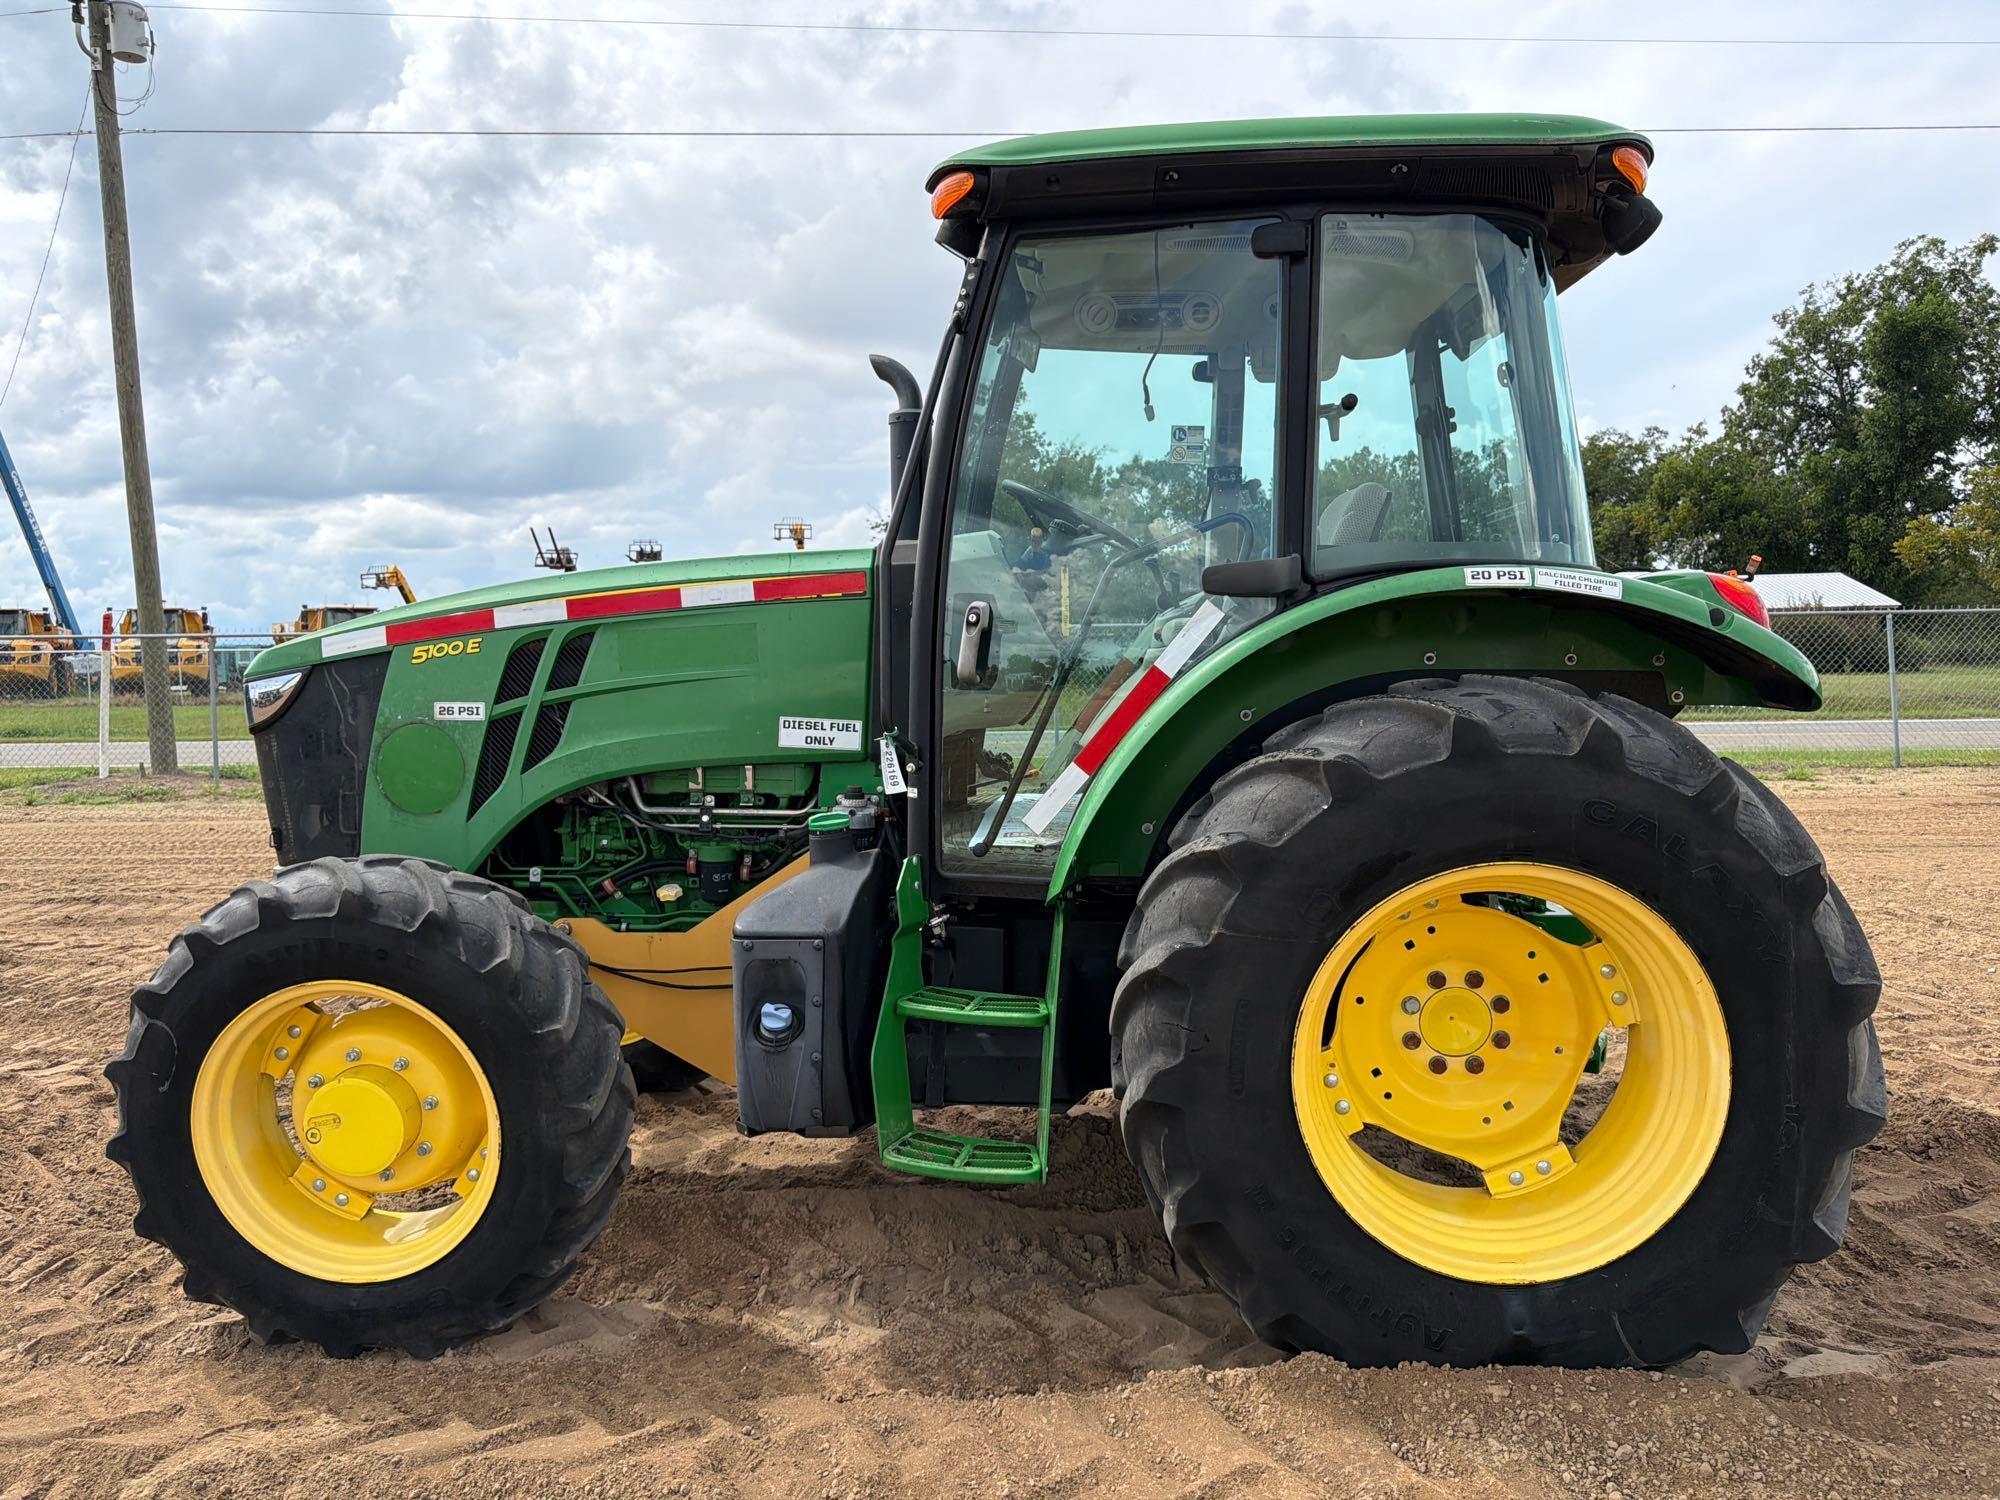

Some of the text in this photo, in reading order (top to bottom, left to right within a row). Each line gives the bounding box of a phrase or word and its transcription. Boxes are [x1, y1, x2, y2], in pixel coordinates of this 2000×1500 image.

[37, 538, 48, 553] XC
[1470, 570, 1526, 581] 20 PSI
[1538, 570, 1619, 588] CALCIUM CHLORIDE
[1554, 579, 1603, 593] FILLED TIRE
[411, 637, 484, 664] 5100 E
[438, 706, 481, 716] 26 PSI
[782, 720, 859, 733] DIESEL FUEL
[804, 735, 836, 746] ONLY
[885, 750, 900, 787] 226169
